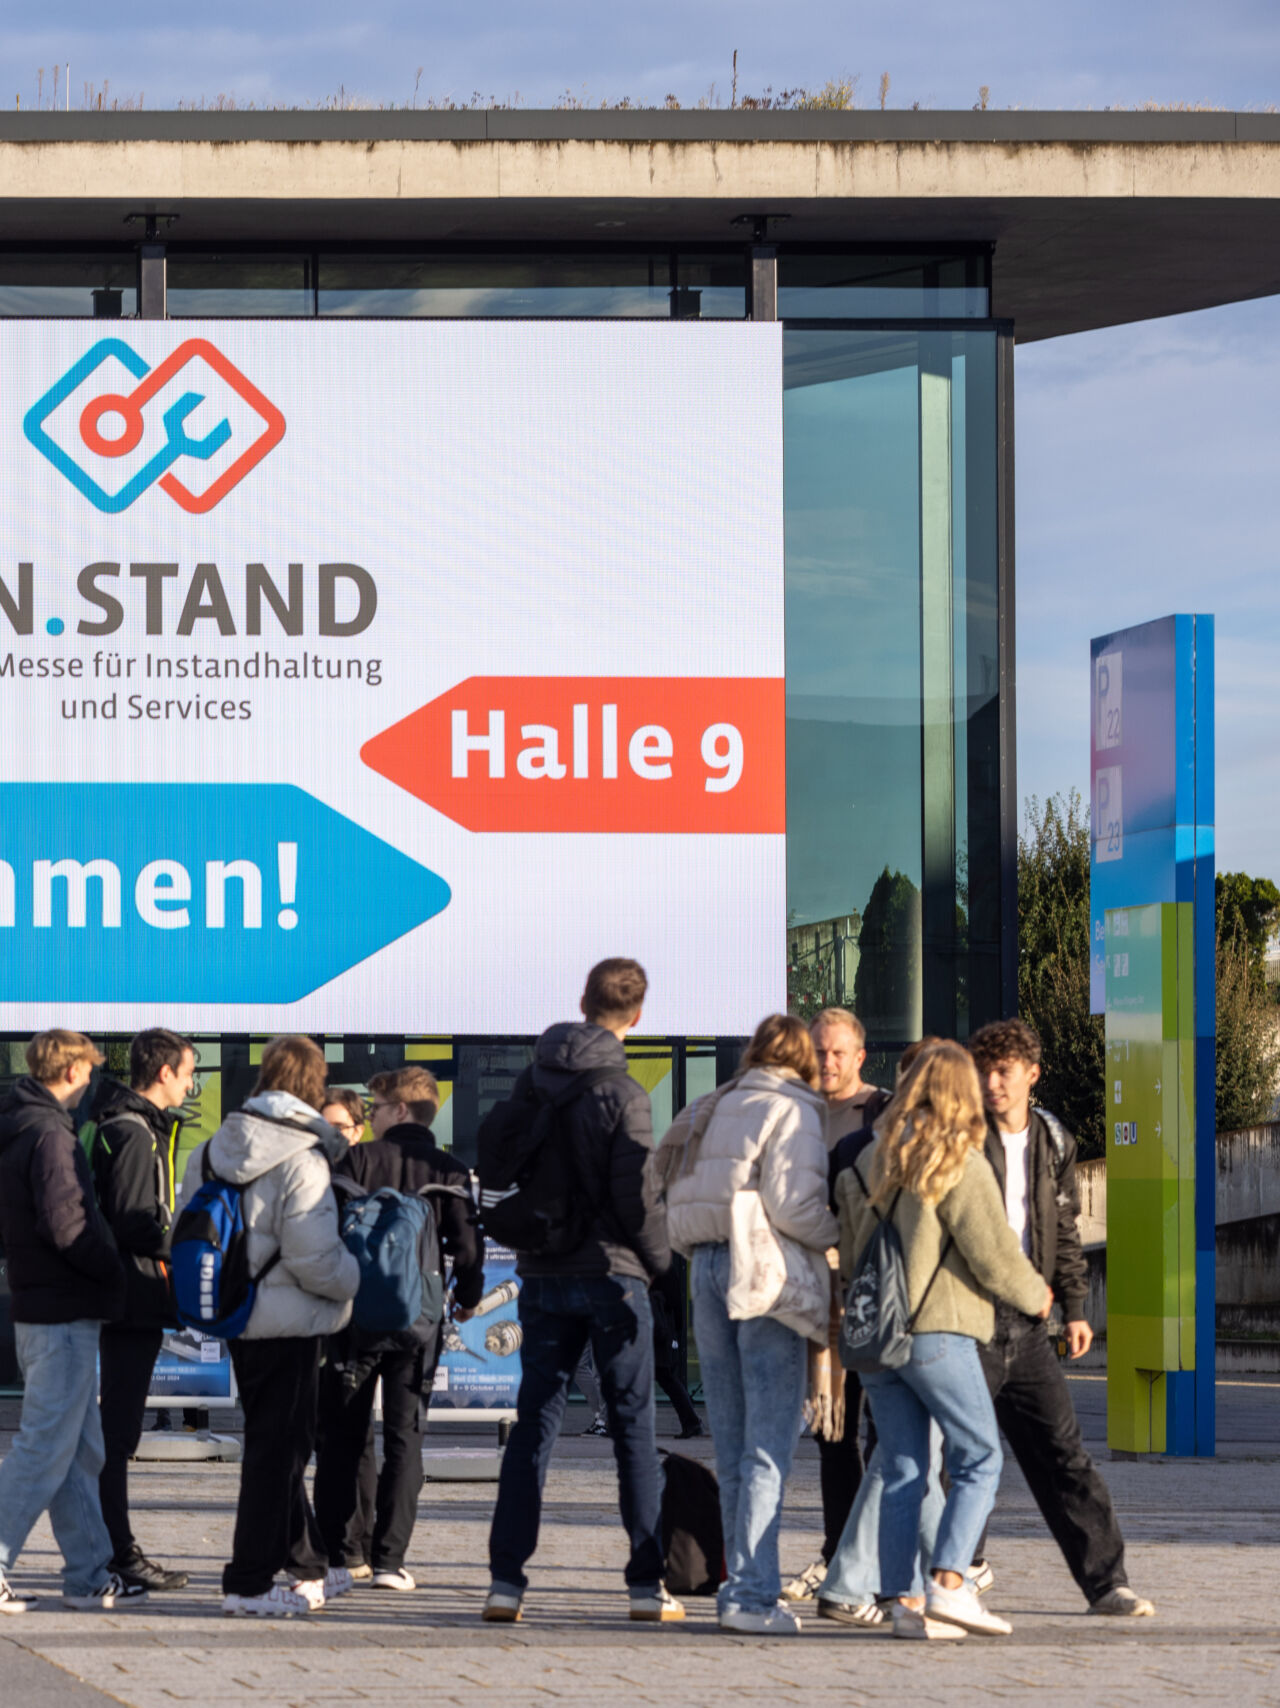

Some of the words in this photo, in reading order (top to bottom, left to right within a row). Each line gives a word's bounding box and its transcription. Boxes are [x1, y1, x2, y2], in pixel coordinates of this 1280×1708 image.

[93, 651, 137, 678] für
[146, 651, 383, 686] Instandhaltung
[61, 694, 117, 720] und
[128, 694, 252, 721] Services
[448, 702, 676, 783] Halle
[699, 720, 746, 794] 9
